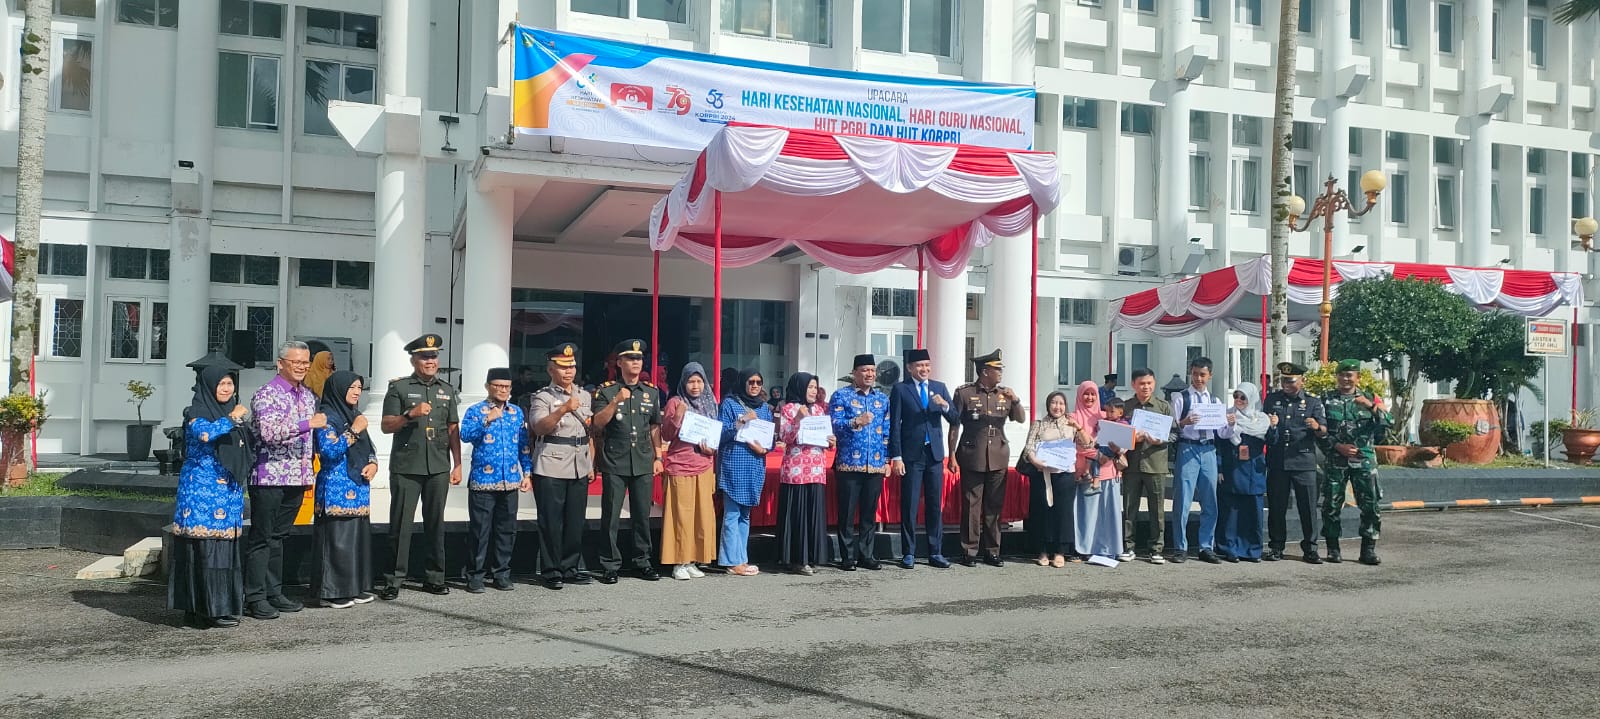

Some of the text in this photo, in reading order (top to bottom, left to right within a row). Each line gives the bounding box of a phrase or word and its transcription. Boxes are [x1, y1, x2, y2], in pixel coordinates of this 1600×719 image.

[665, 86, 691, 115] 79
[706, 88, 724, 109] 53
[867, 87, 909, 104] UPACARA
[741, 90, 1026, 136] HARI KESEHATAN NASIONAL, HARI GURU NASIONAL,
[814, 117, 961, 144] HUT PGRI DAN HUT KORPRI
